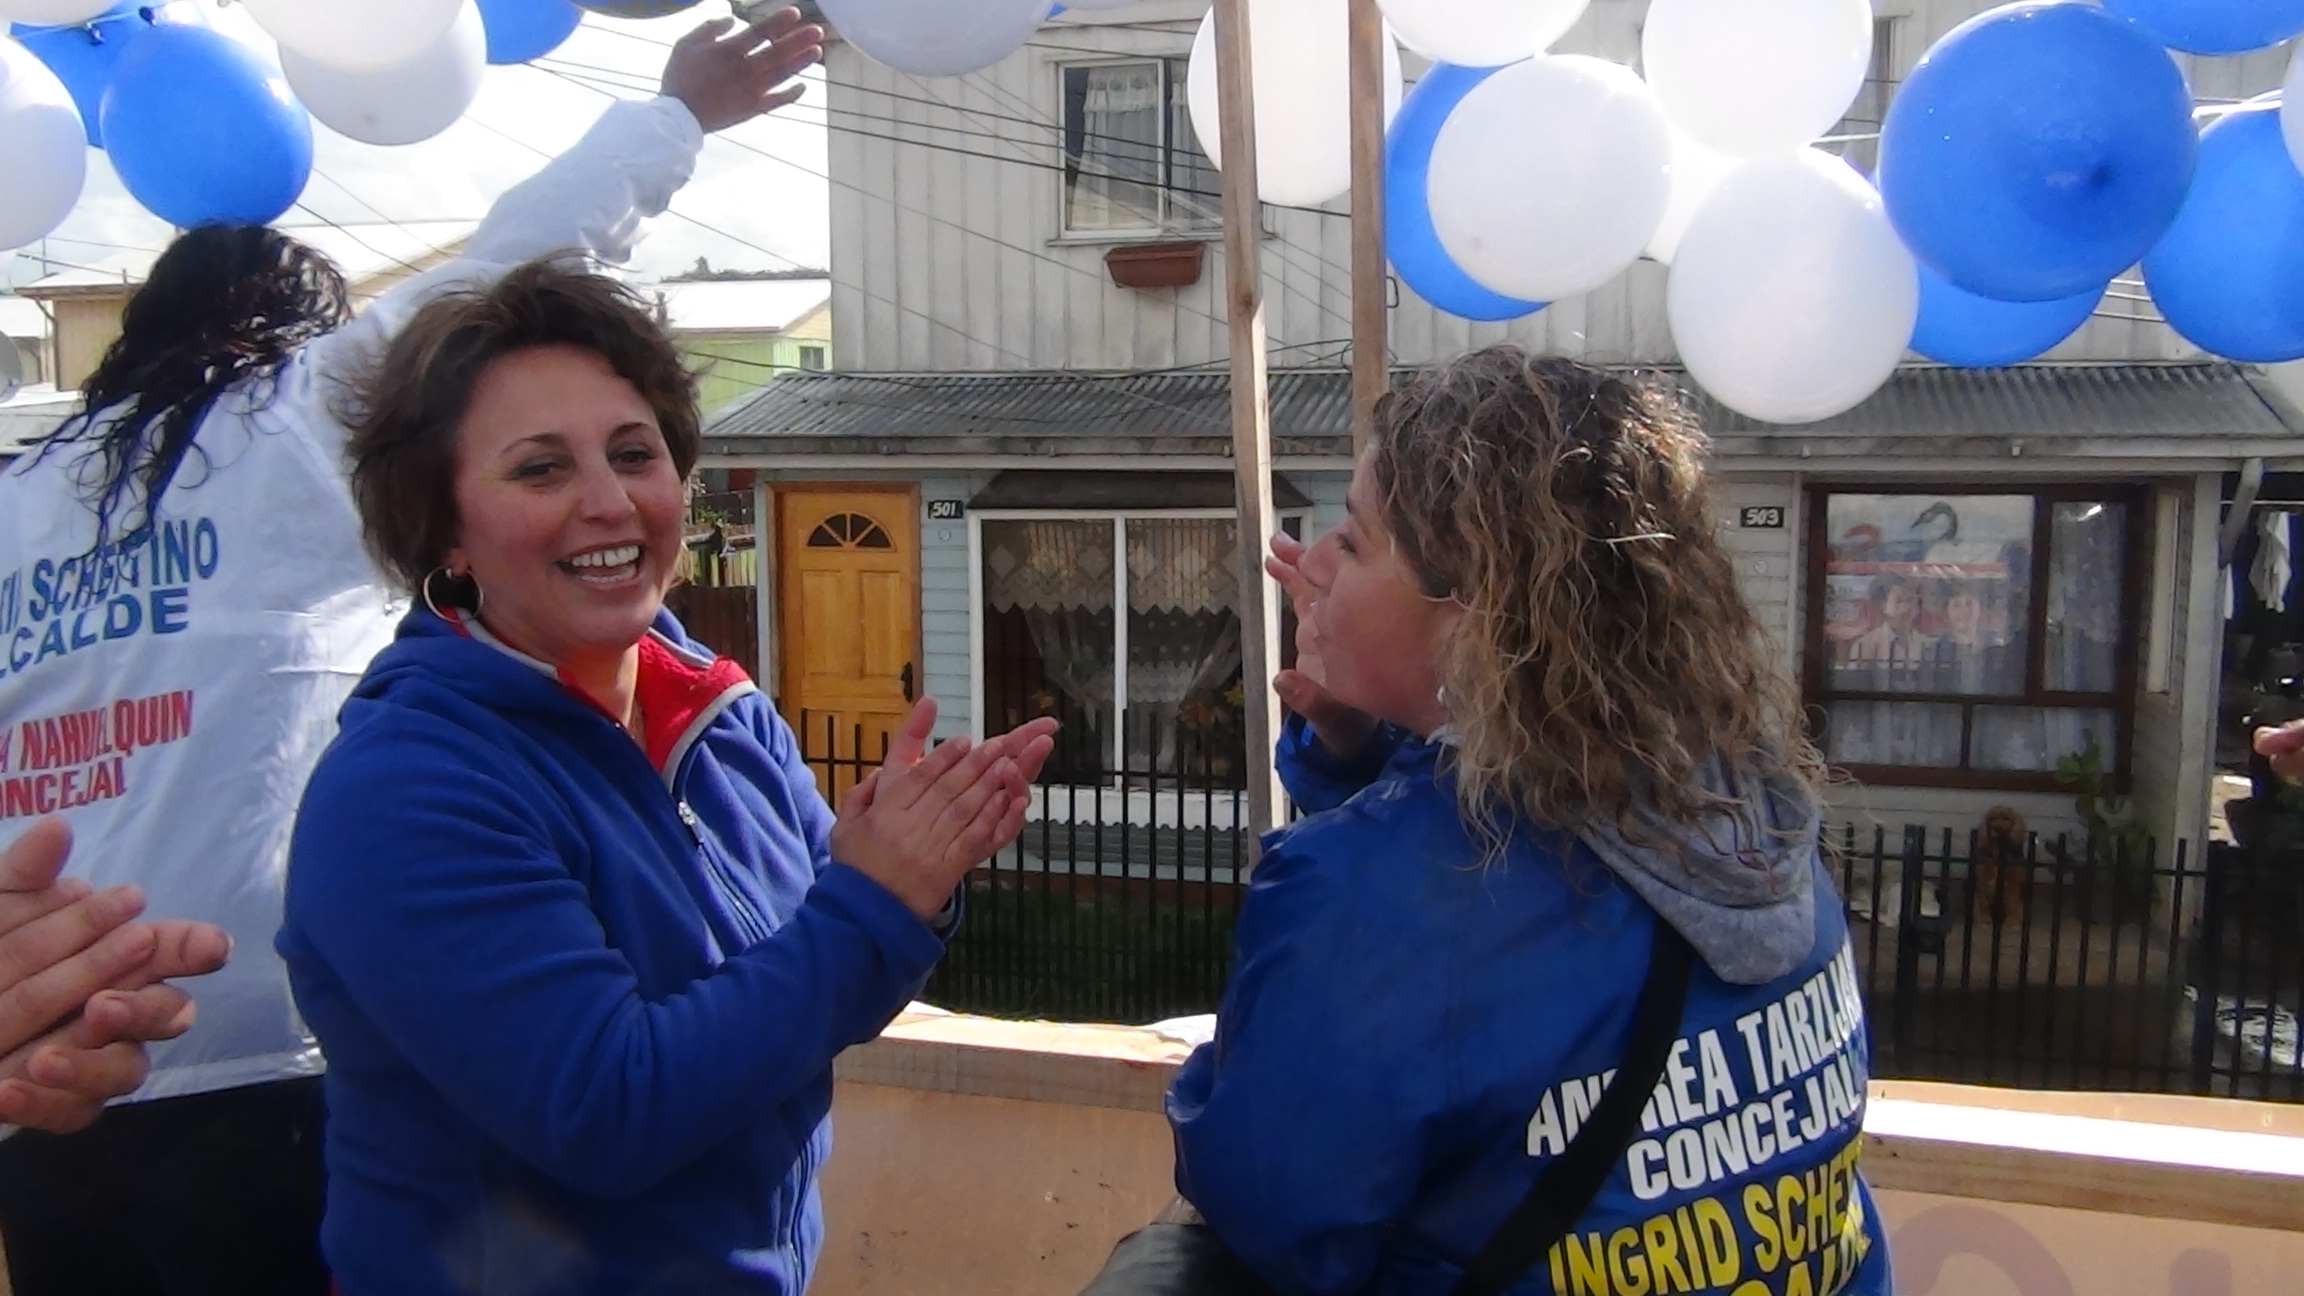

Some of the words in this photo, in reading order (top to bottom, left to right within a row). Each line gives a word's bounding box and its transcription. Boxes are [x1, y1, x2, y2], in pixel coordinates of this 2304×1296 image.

[931, 501, 957, 517] 501
[1746, 508, 1779, 526] 503
[0, 587, 190, 679] CALDE
[0, 756, 129, 820] NCEJAL
[1526, 1029, 1739, 1157] ANREA
[1627, 1053, 1862, 1200] CONCEJAL
[1547, 1197, 1741, 1296] INGRID
